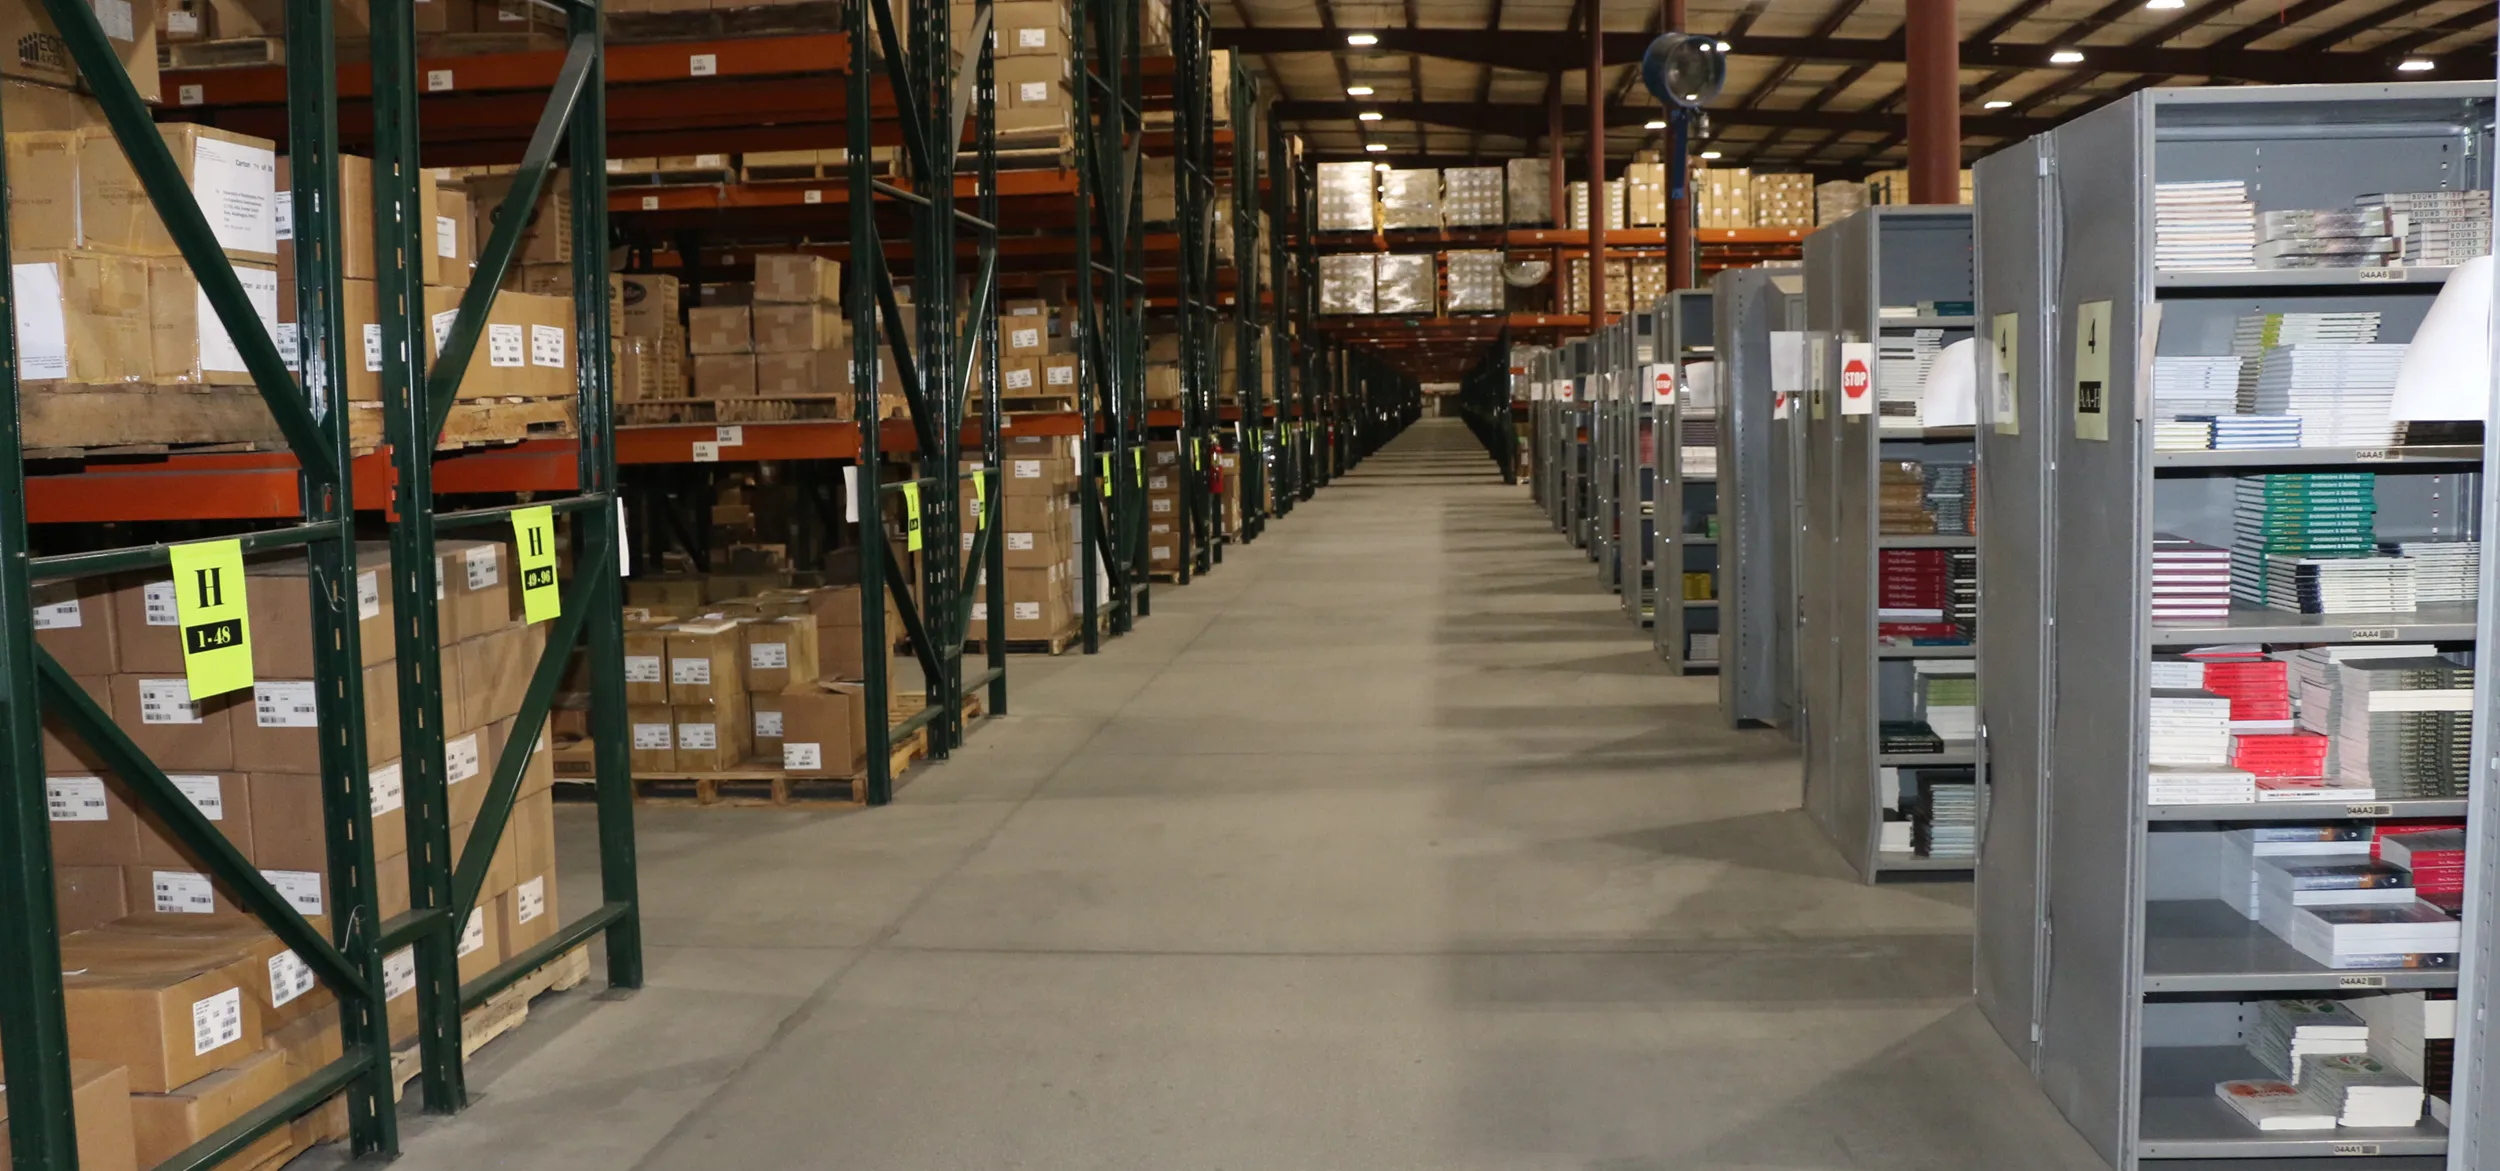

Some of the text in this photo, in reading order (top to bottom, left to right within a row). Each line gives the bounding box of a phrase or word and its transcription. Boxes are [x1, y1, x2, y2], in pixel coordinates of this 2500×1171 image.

[2360, 270, 2388, 279] 04AA6
[2088, 318, 2096, 354] 4
[1844, 371, 1867, 387] STOP
[2356, 451, 2383, 459] 04AA5
[528, 526, 544, 556] H
[527, 569, 551, 587] 49-96
[195, 567, 225, 609] H
[197, 625, 231, 649] 1-48
[2352, 630, 2379, 638] 04AA4
[2347, 806, 2373, 814] 04AA3
[2340, 977, 2367, 985] 04AA2
[2334, 1145, 2361, 1153] 04AA1
